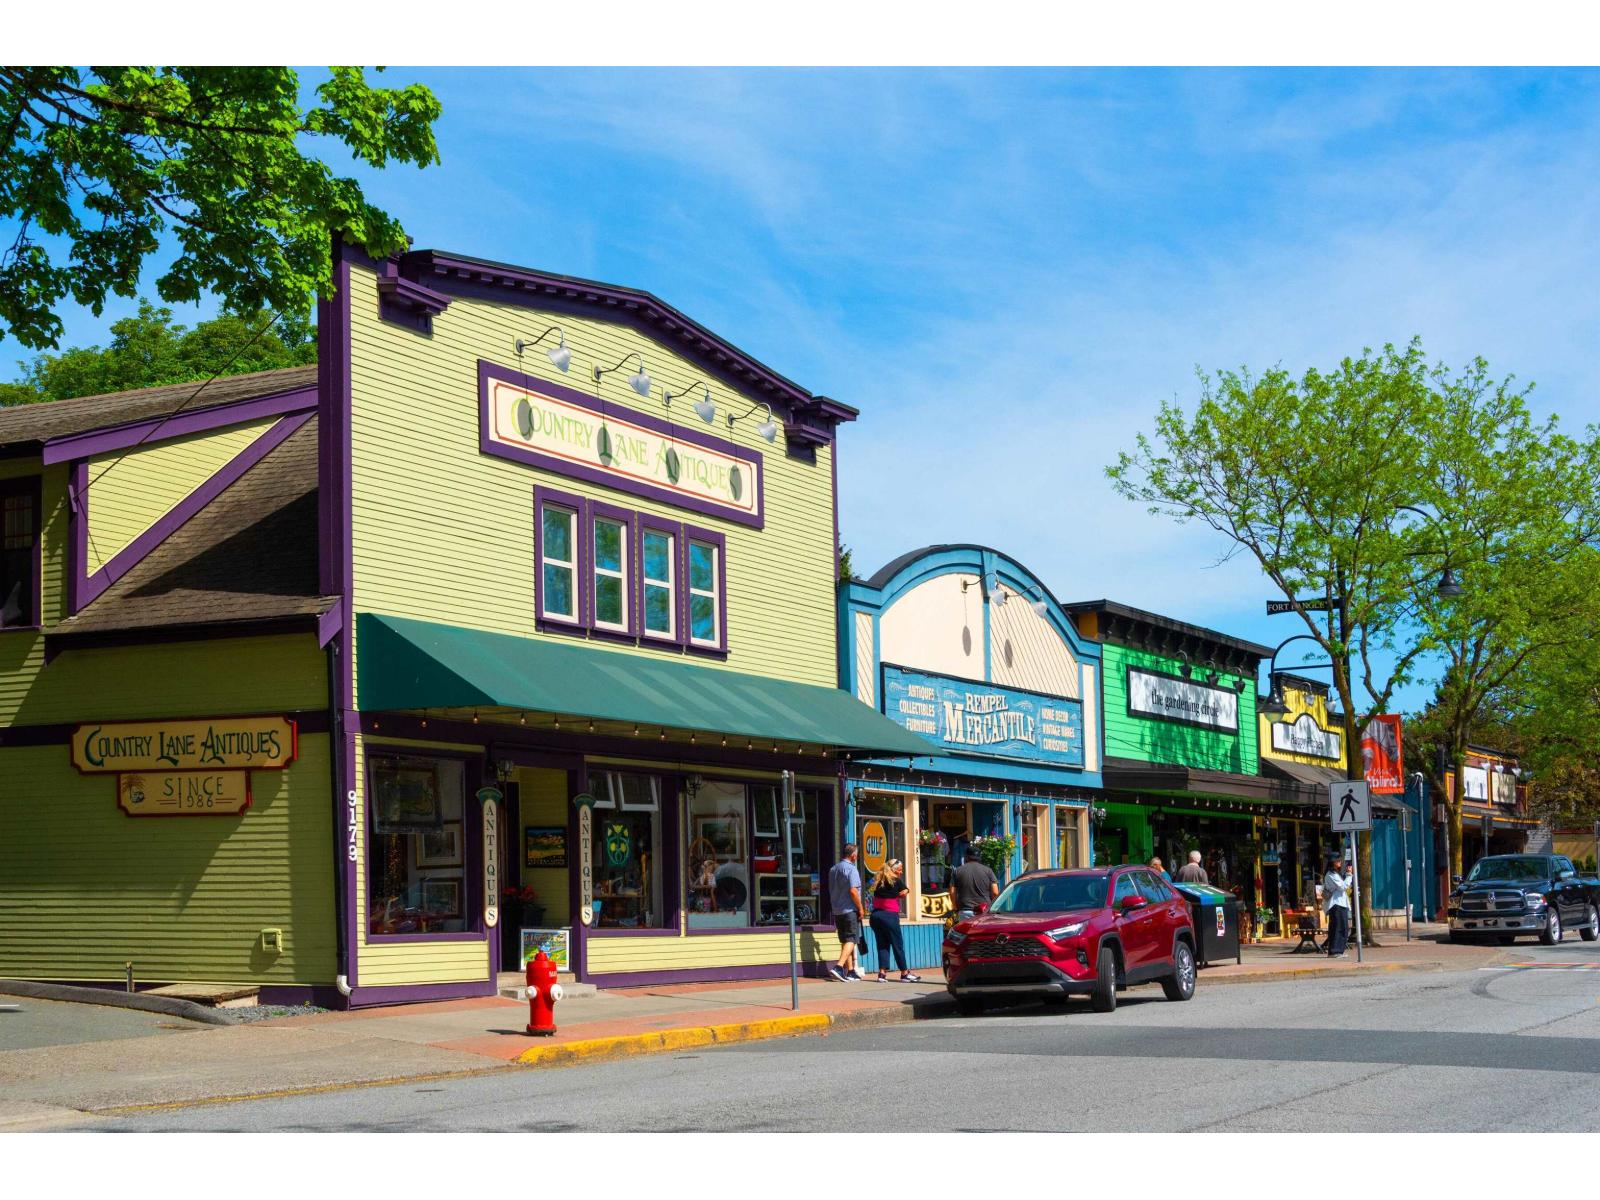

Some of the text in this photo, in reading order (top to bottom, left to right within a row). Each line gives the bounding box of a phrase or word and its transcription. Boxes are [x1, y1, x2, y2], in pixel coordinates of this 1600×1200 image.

[511, 398, 740, 502] COUNTRY LANE ANTIQUES
[1267, 603, 1289, 611] FORT
[908, 684, 935, 701] ANTIQUES
[965, 692, 1009, 713] REMPEL
[1152, 689, 1219, 717] the gardening circle
[899, 700, 935, 717] COLLECTIBLES
[906, 718, 936, 734] FURNITURE
[943, 701, 1036, 745] MERCANTILE
[85, 726, 281, 767] COUNTRY LANE ANTIQUES
[163, 776, 224, 796] SINCE
[178, 795, 214, 808] 1986
[348, 790, 357, 861] 9179
[866, 835, 883, 857] GULF
[486, 805, 495, 920] ANTIQUES
[582, 811, 591, 919] ANTIQUES
[920, 895, 953, 914] PEN
